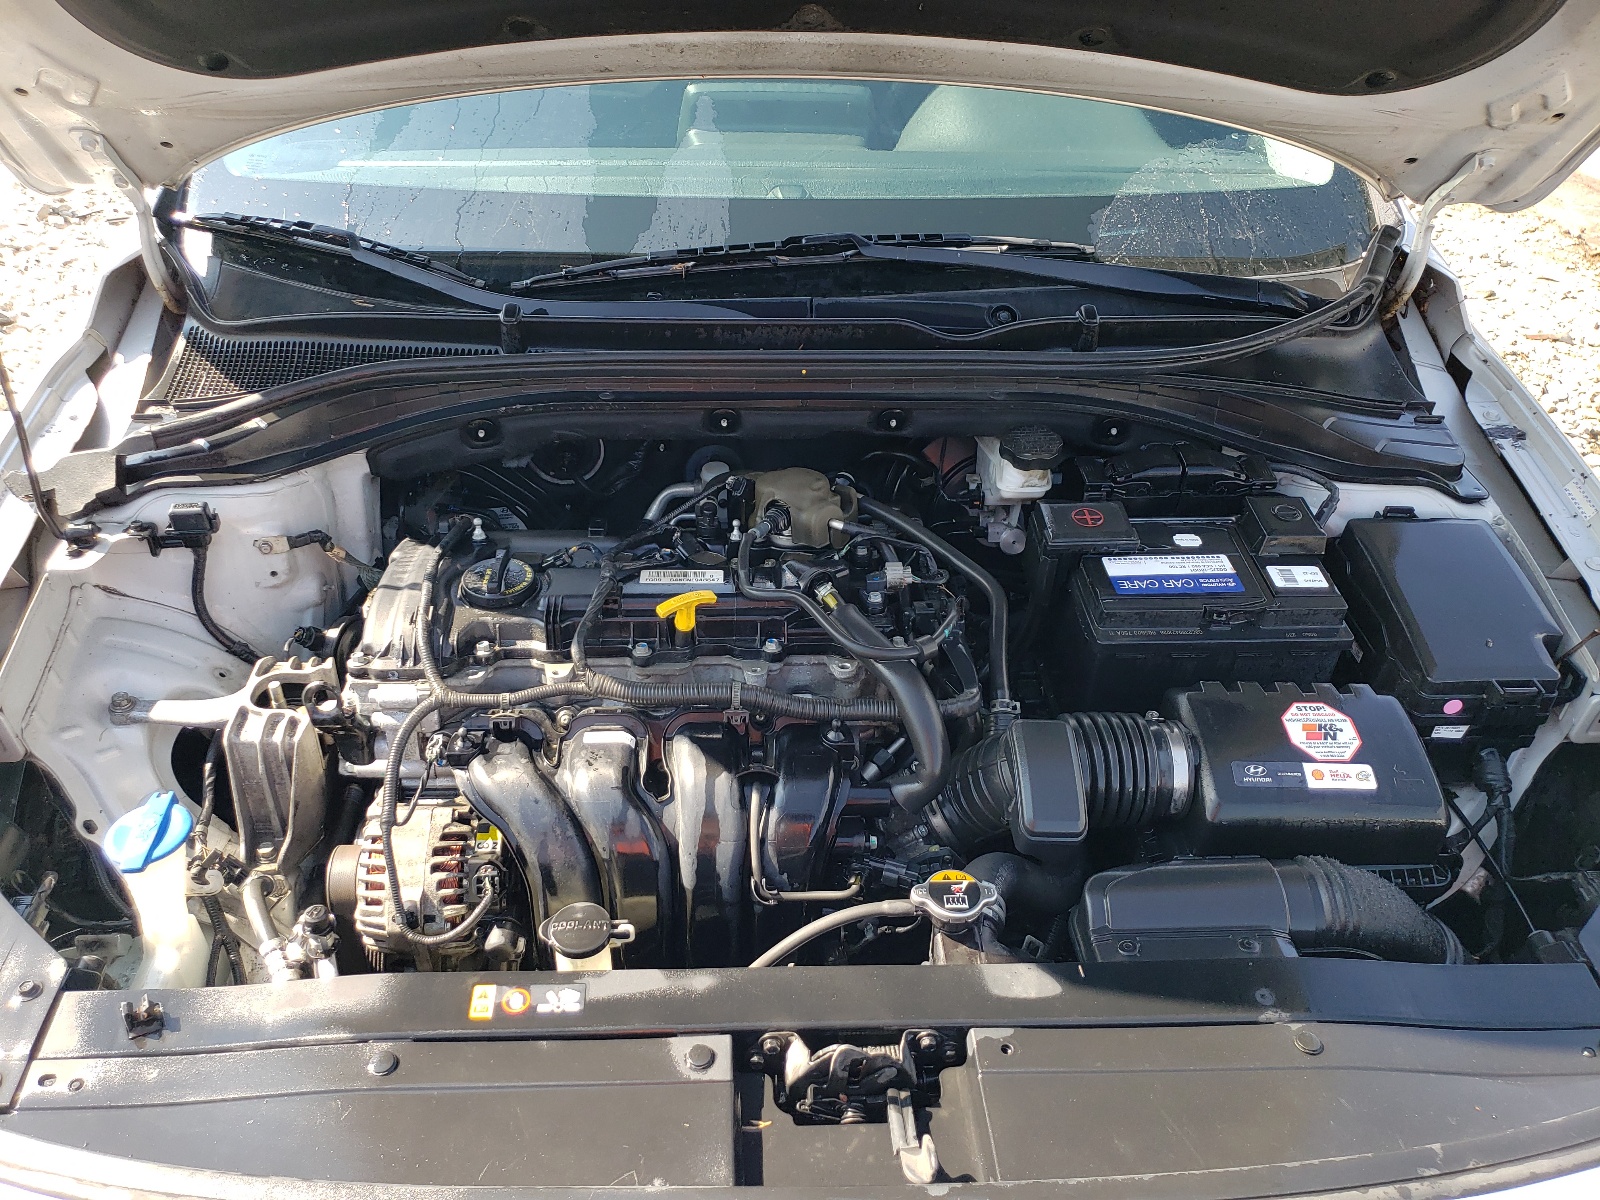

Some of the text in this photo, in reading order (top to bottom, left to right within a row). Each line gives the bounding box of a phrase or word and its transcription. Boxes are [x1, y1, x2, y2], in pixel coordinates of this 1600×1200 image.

[1117, 578, 1194, 589] CAR CARE
[551, 919, 610, 931] COOLANT
